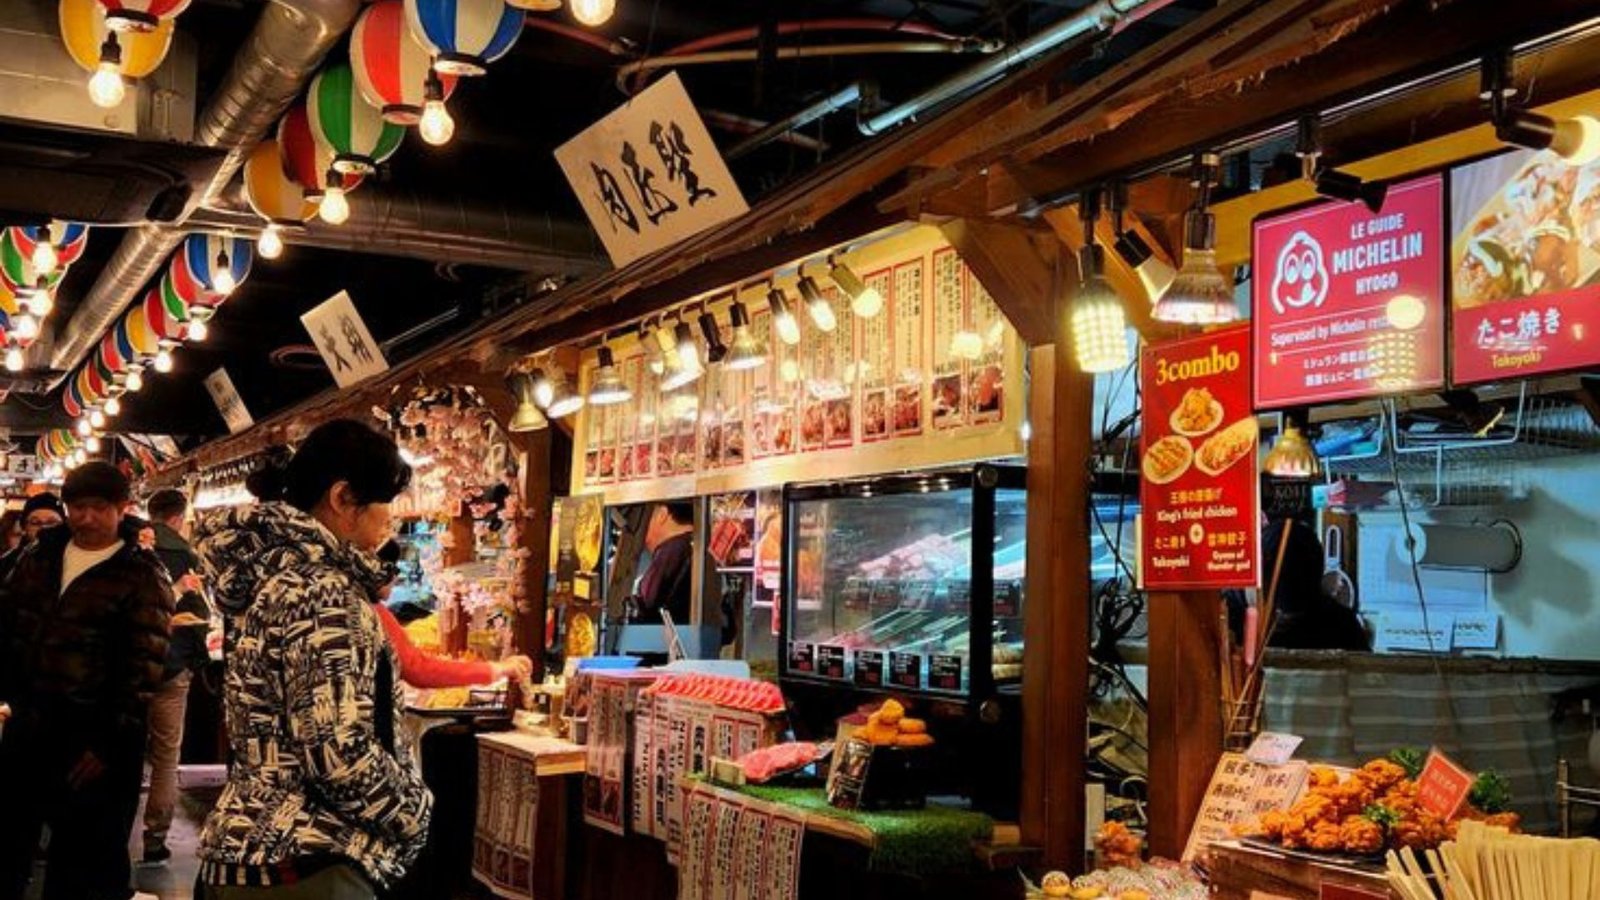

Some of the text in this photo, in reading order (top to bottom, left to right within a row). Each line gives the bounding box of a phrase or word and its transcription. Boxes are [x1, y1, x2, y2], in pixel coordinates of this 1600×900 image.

[1352, 213, 1405, 240] LE GUIDE
[1332, 232, 1424, 275] MICHELIN
[1355, 272, 1399, 295] HYOGO
[1271, 327, 1316, 347] Supervised
[1317, 325, 1328, 340] by
[1330, 317, 1366, 335] Michelin
[1478, 306, 1560, 345] たこ焼き
[1156, 344, 1240, 386] 3combo
[1491, 350, 1542, 368] Takoyaki
[1157, 505, 1238, 523] King's fried chicken
[1152, 555, 1190, 569] Takoyaki
